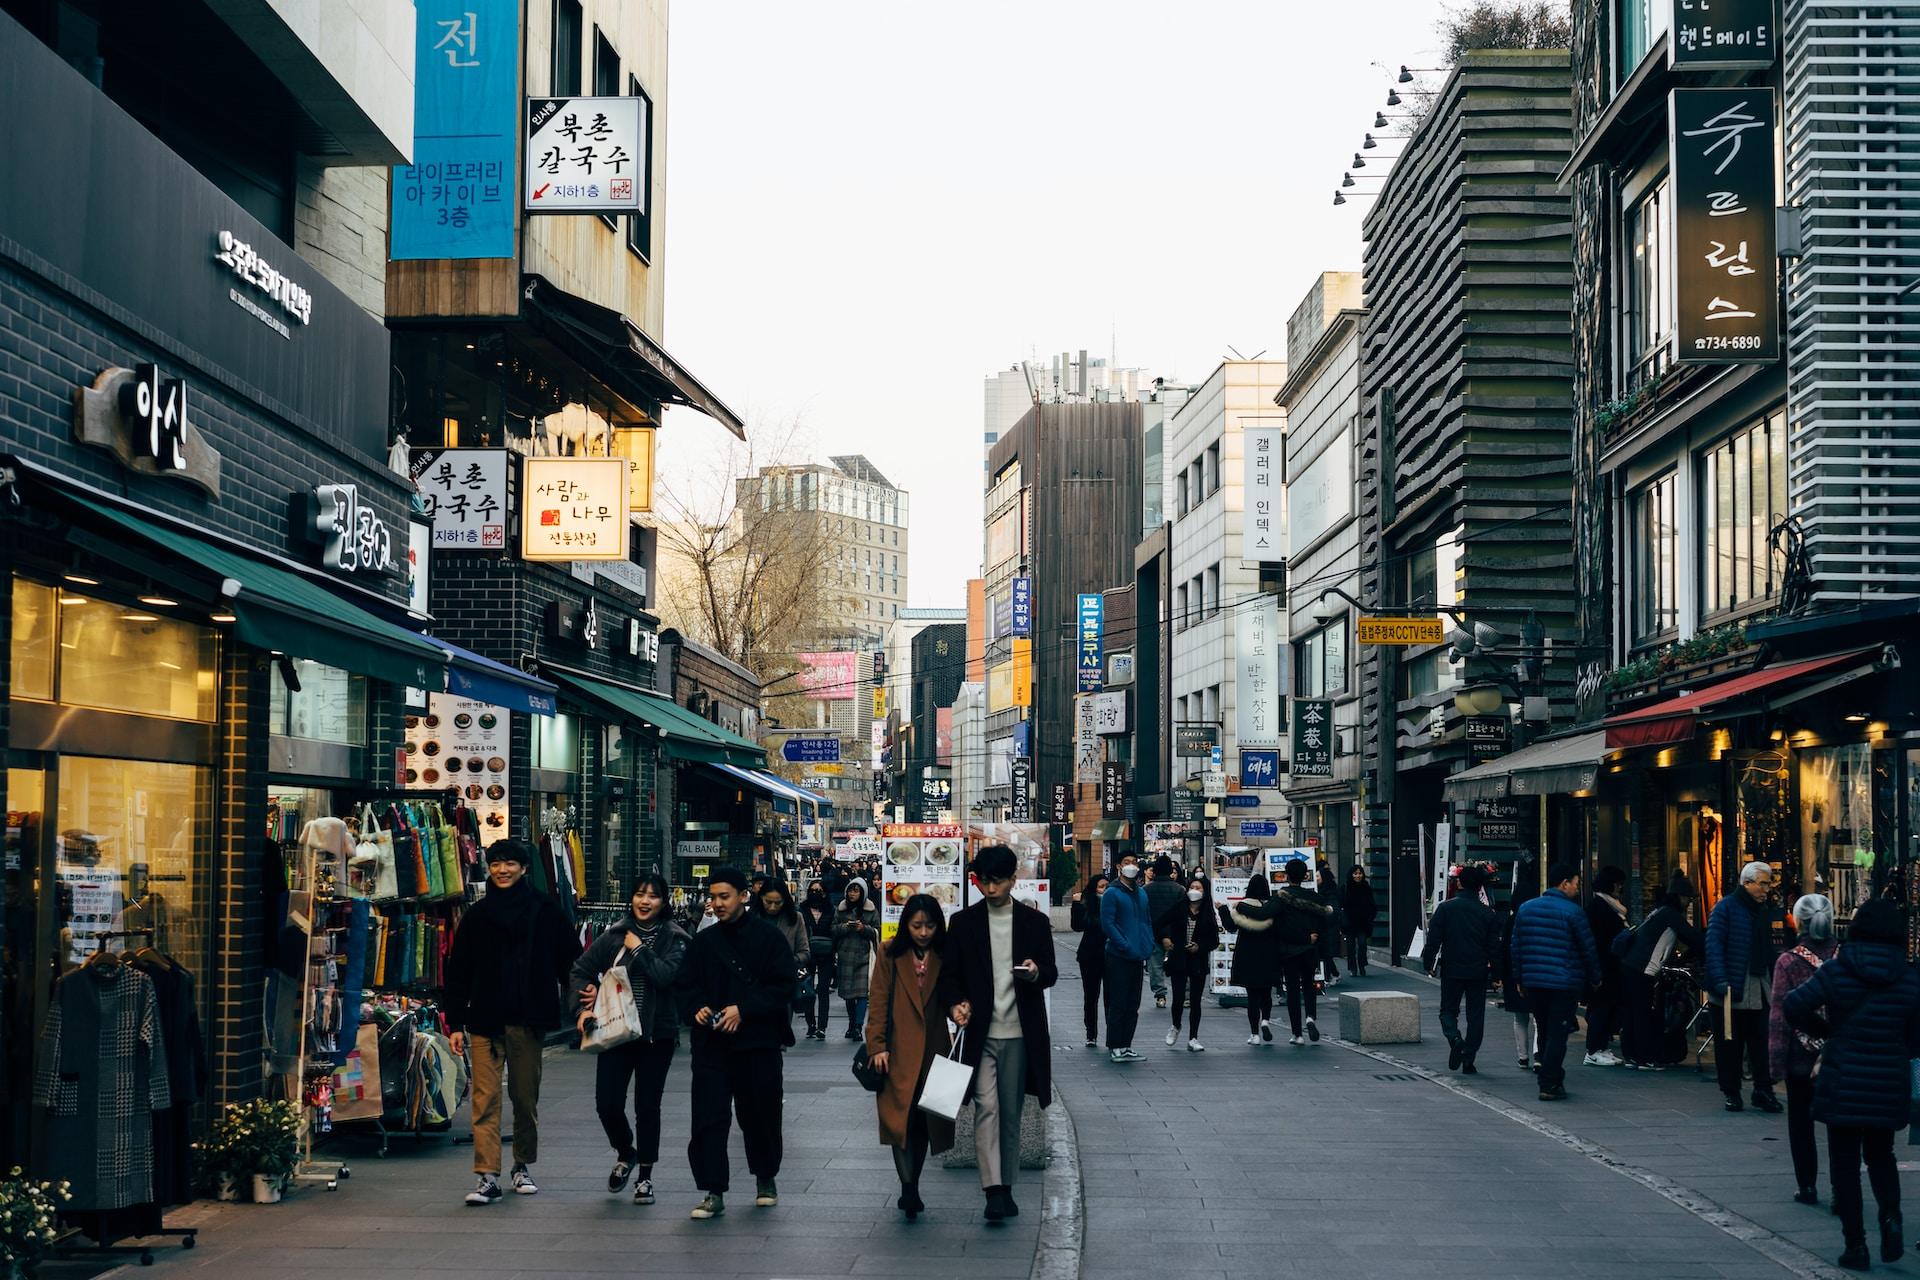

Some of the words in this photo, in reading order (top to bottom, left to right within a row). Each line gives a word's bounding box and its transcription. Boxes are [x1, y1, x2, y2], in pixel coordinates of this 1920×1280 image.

[434, 12, 480, 67] 전
[1680, 25, 1766, 50] 핸드메이드
[531, 101, 557, 126] 인사동
[555, 113, 614, 143] 북촌
[537, 146, 630, 175] 칼국수
[404, 161, 503, 184] 라이프러리
[406, 183, 502, 207] 아카이브
[553, 184, 600, 198] 지하1층
[437, 206, 470, 228] 3층
[1706, 336, 1761, 350] 734-6890
[410, 451, 434, 474] 인사동
[1256, 437, 1270, 487] 갤러리
[431, 462, 487, 491] 북촌
[536, 480, 590, 502] 사람과
[573, 505, 612, 522] 나무
[1256, 500, 1270, 549] 인덱스
[434, 530, 479, 543] 지하1층
[549, 532, 597, 546] 전통찻집
[1361, 624, 1441, 640] 불법주정차CCTV단속중
[1294, 765, 1331, 774] 739-8595
[678, 845, 693, 854] TAL
[695, 845, 720, 854] BANG
